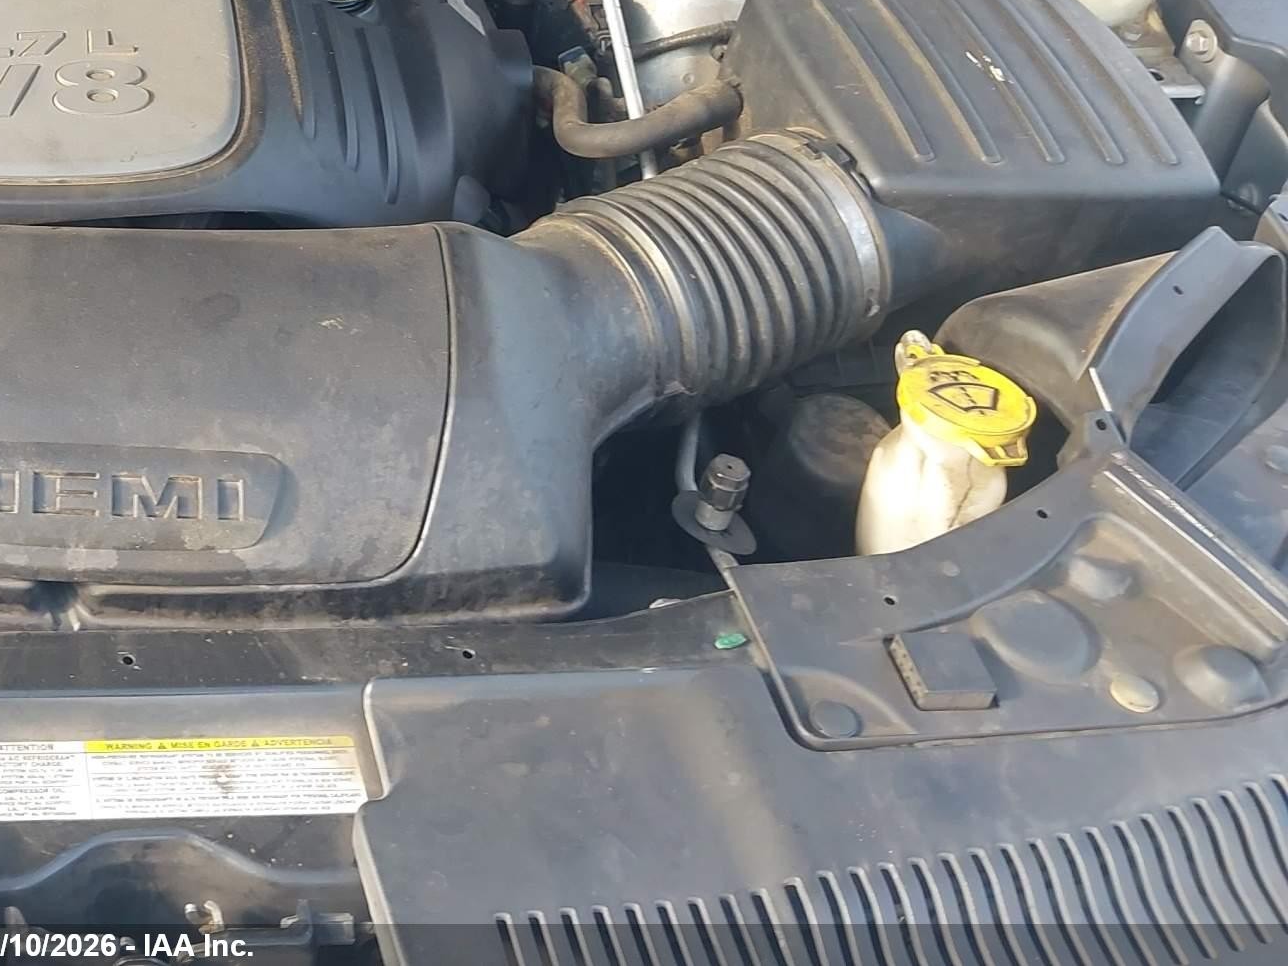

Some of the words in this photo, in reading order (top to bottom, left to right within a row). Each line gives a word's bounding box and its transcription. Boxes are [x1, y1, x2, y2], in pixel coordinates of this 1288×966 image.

[106, 742, 152, 751] WARNING
[170, 741, 194, 749] MISE
[214, 740, 248, 748] GARDE
[264, 738, 332, 747] ADVERTENCIA
